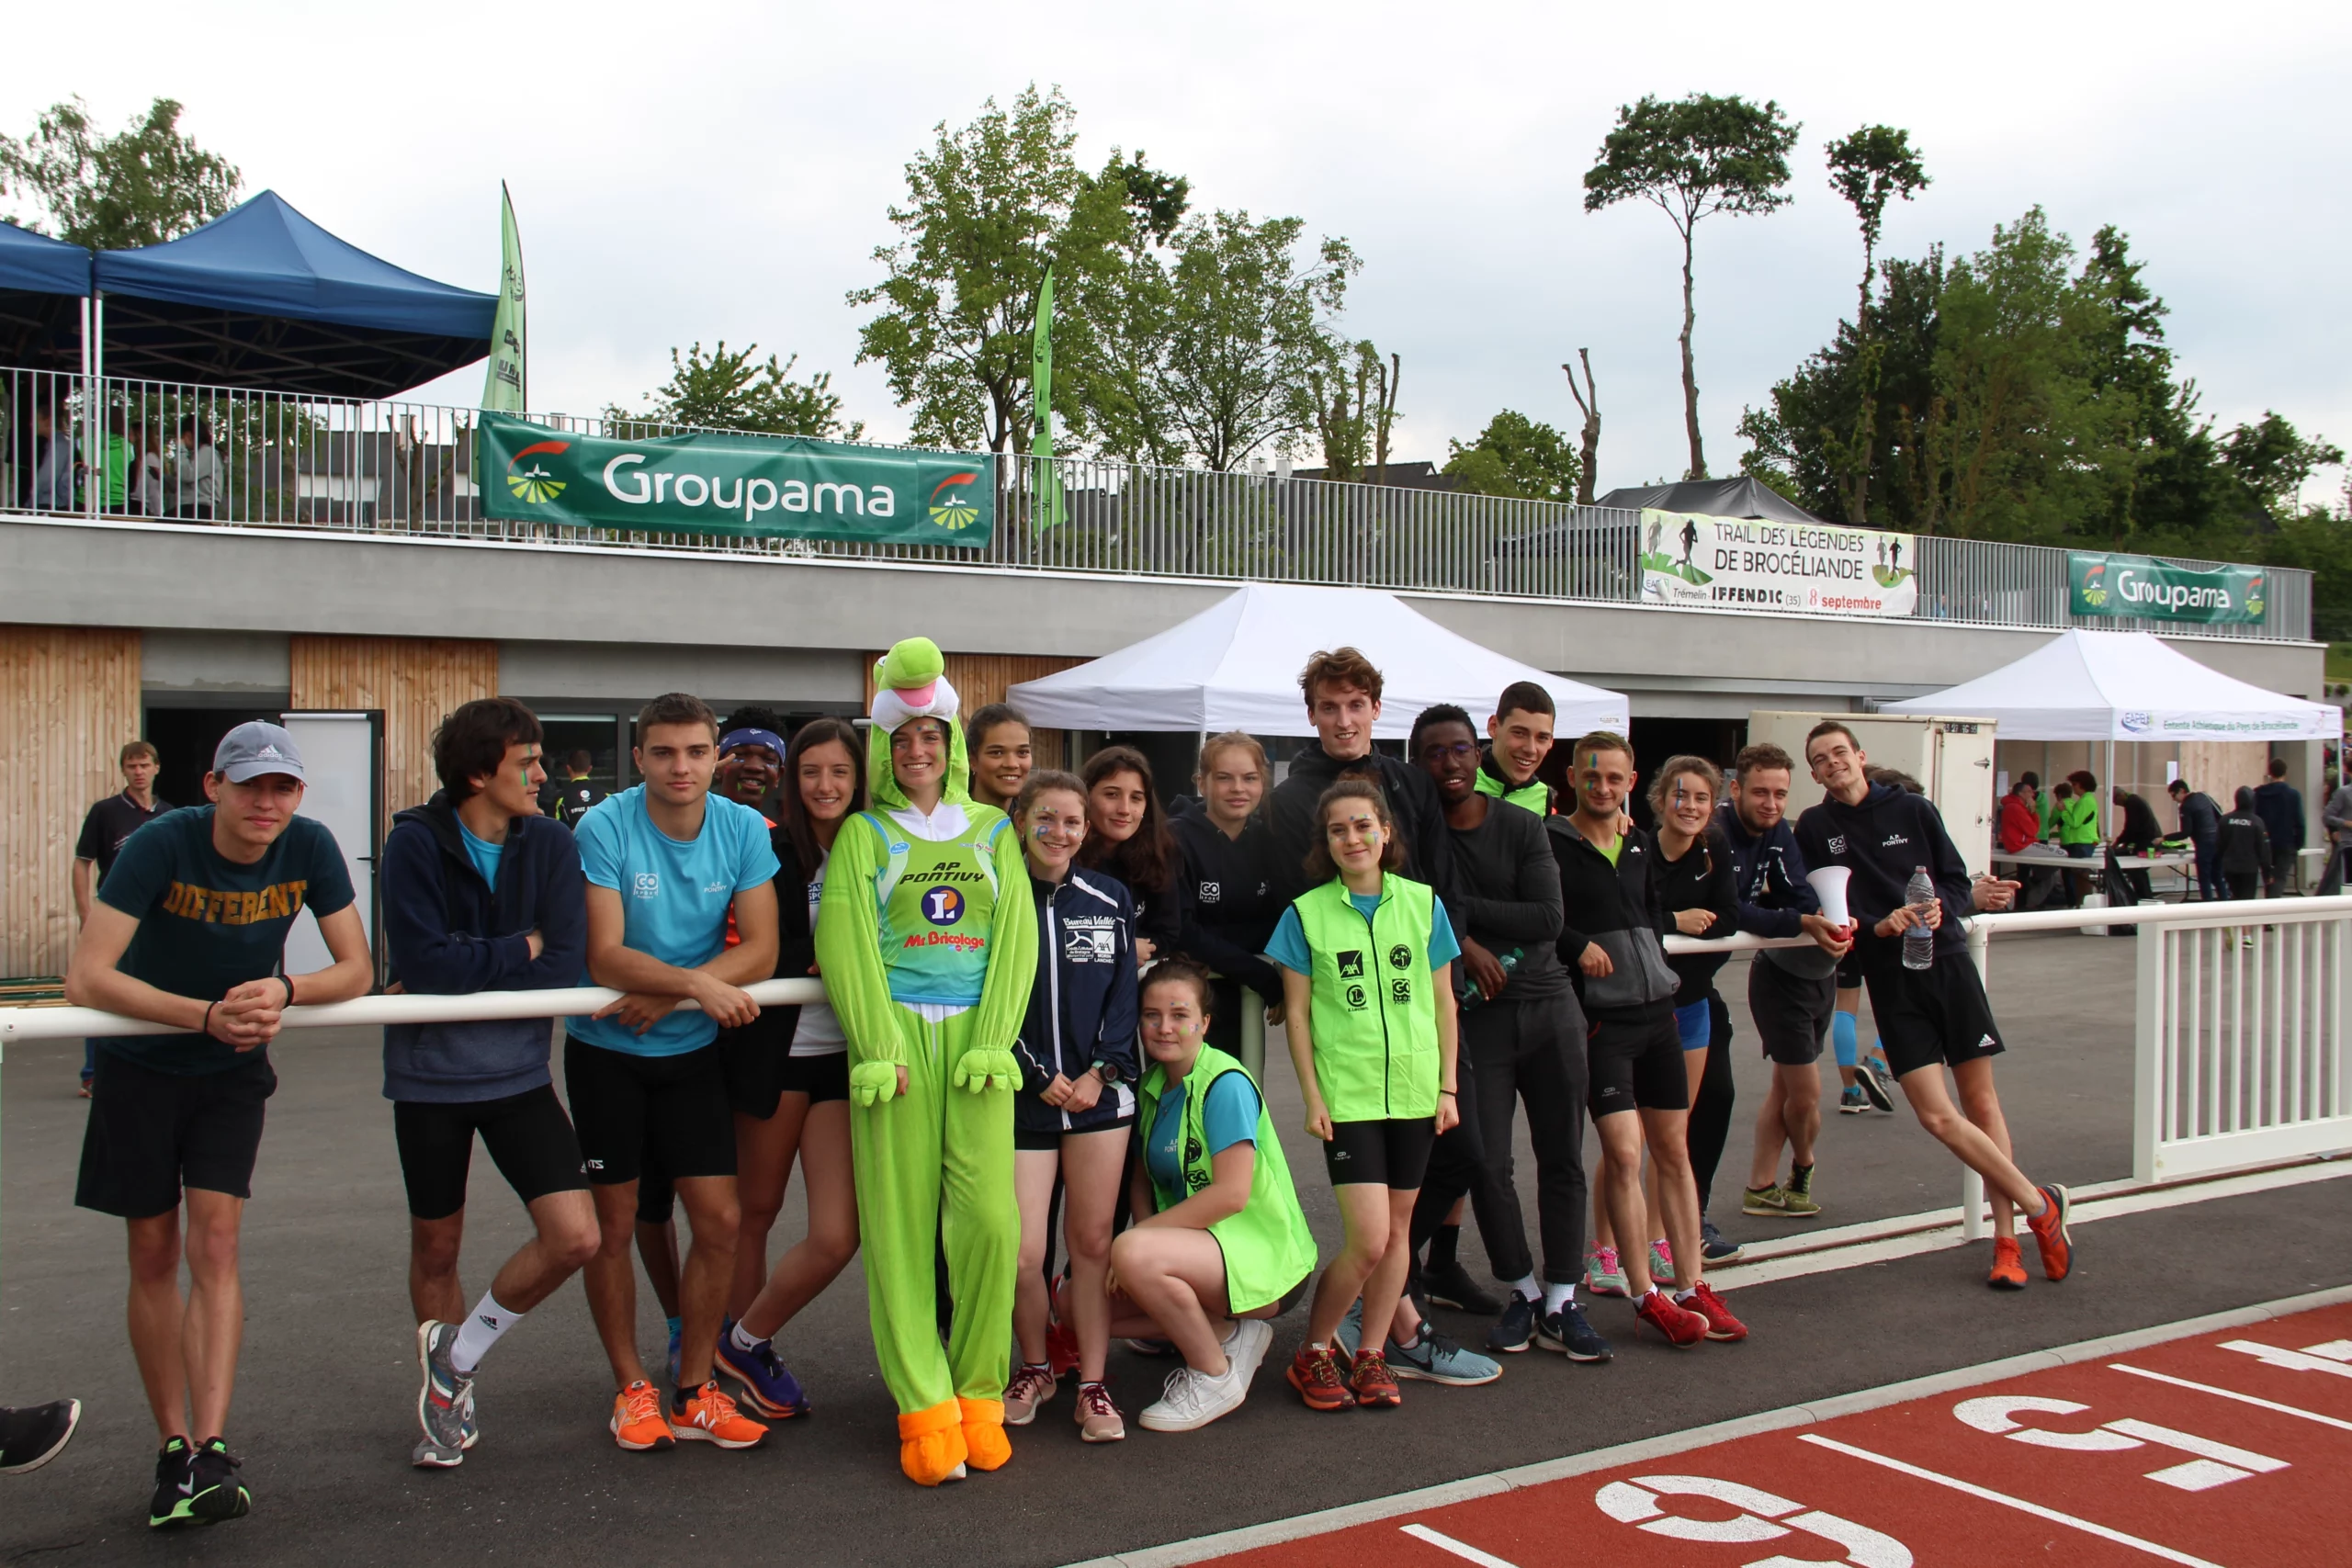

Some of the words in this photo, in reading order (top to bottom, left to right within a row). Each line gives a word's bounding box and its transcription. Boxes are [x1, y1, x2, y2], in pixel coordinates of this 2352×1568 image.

[603, 452, 895, 522] Groupama
[1714, 523, 1756, 544] TRAIL
[1760, 526, 1785, 546] DES
[1791, 526, 1864, 552] LÉGENDES
[1714, 549, 1738, 570] DE
[1744, 550, 1863, 580] BROCÉLIANDE
[1673, 588, 1707, 600] Trémelin
[1712, 586, 1782, 604] IFFENDIC
[1785, 593, 1801, 607] (35)
[1809, 588, 1817, 606] 8
[1822, 595, 1882, 610] septembre
[2117, 570, 2232, 613] Groupama
[258, 752, 283, 761] adidas
[1882, 838, 1908, 847] PONTIVY
[933, 863, 961, 871] AP
[637, 873, 658, 890] GO
[899, 872, 985, 886] PONTIVY
[703, 885, 728, 893] PONTIVY
[808, 884, 823, 892] CAS
[808, 892, 822, 900] SPO
[1201, 882, 1220, 897] GO
[163, 879, 307, 925] DIFFERENT
[930, 893, 956, 919] L
[1063, 917, 1093, 926] Bureau
[1093, 915, 1115, 926] Vallée
[903, 934, 925, 948] Mr
[928, 931, 985, 949] Bricolage
[1340, 964, 1361, 976] AXA
[1952, 1395, 2292, 1493] 5
[1595, 1474, 1914, 1568] 6
